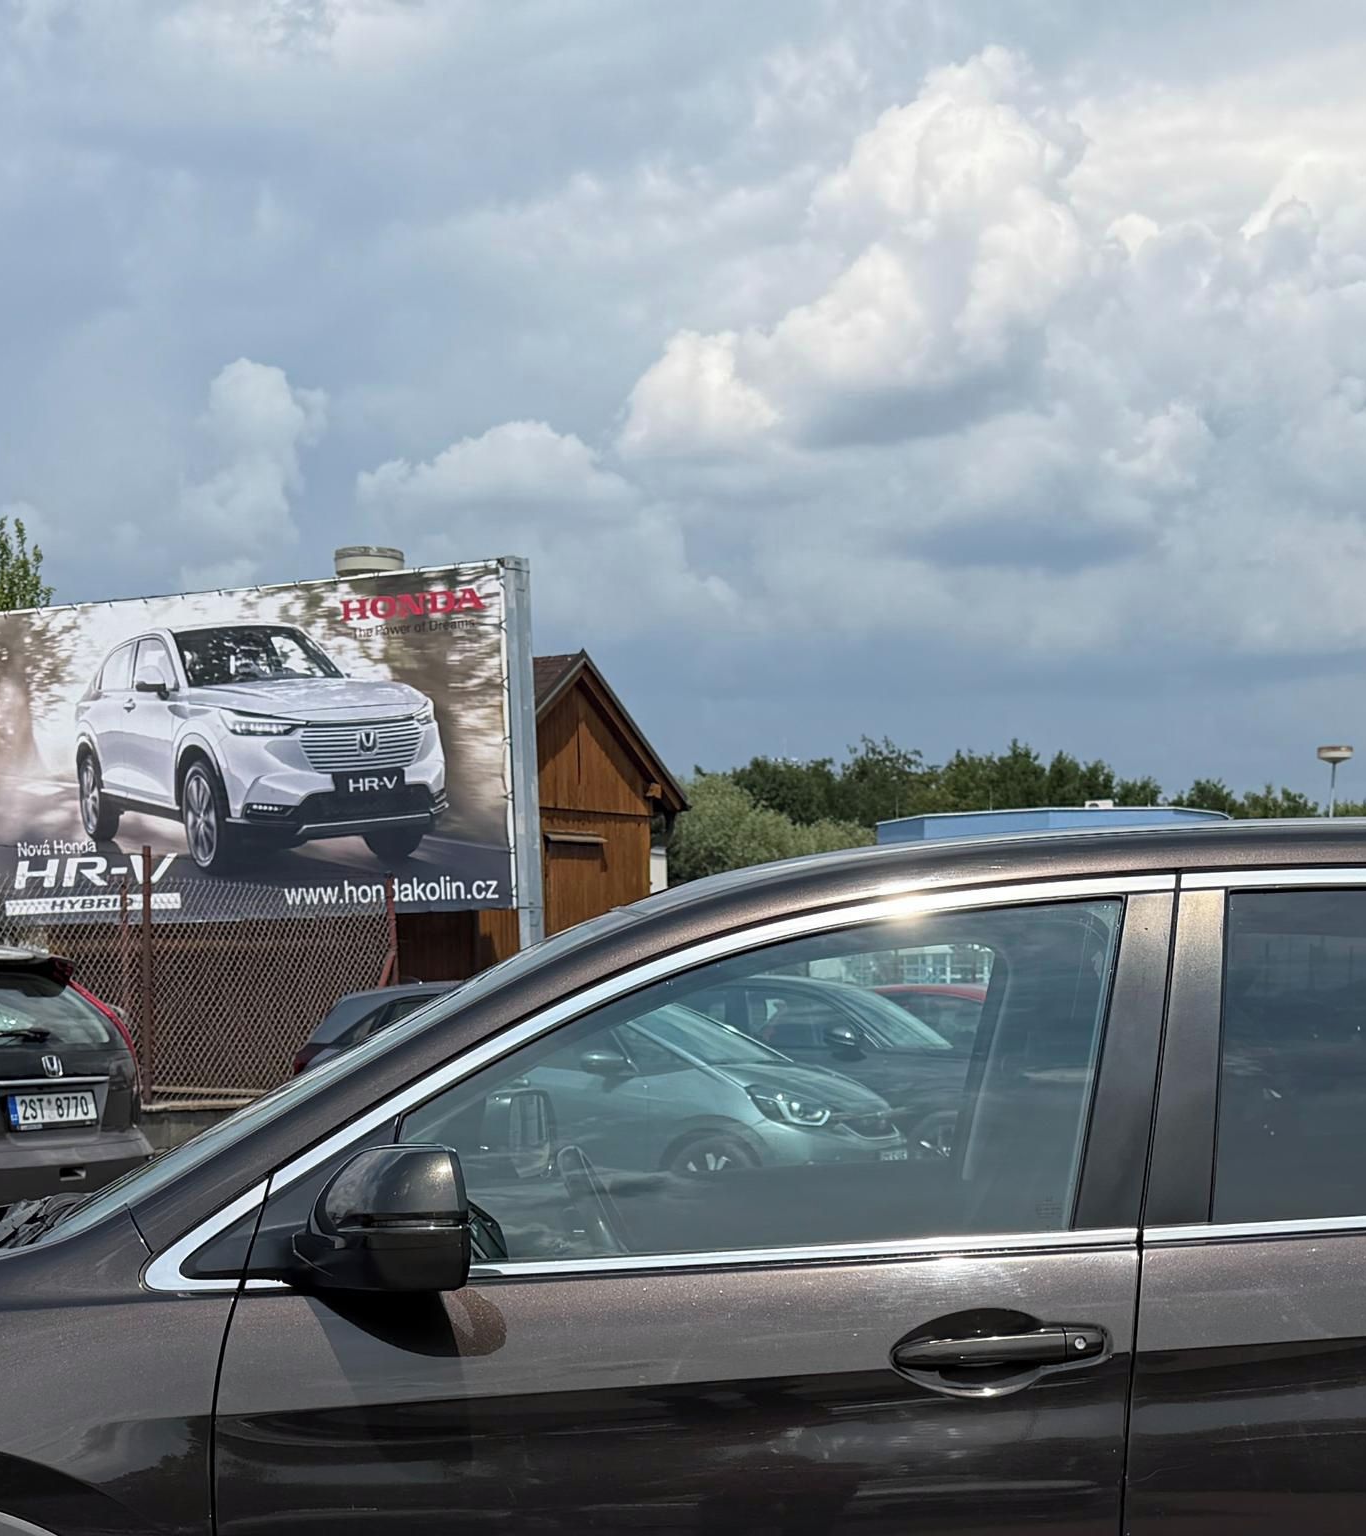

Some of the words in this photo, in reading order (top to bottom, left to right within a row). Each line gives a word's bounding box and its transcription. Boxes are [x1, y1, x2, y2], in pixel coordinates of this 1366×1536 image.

[340, 588, 485, 624] HONDA
[353, 627, 373, 639] The
[375, 623, 410, 636] Power
[414, 621, 427, 632] of
[348, 775, 398, 793] HR-V
[17, 839, 51, 857] Nová
[54, 838, 97, 856] Honda
[14, 852, 178, 889] HR-V
[20, 1097, 45, 1121] 2ST
[56, 1095, 89, 1118] 8770
